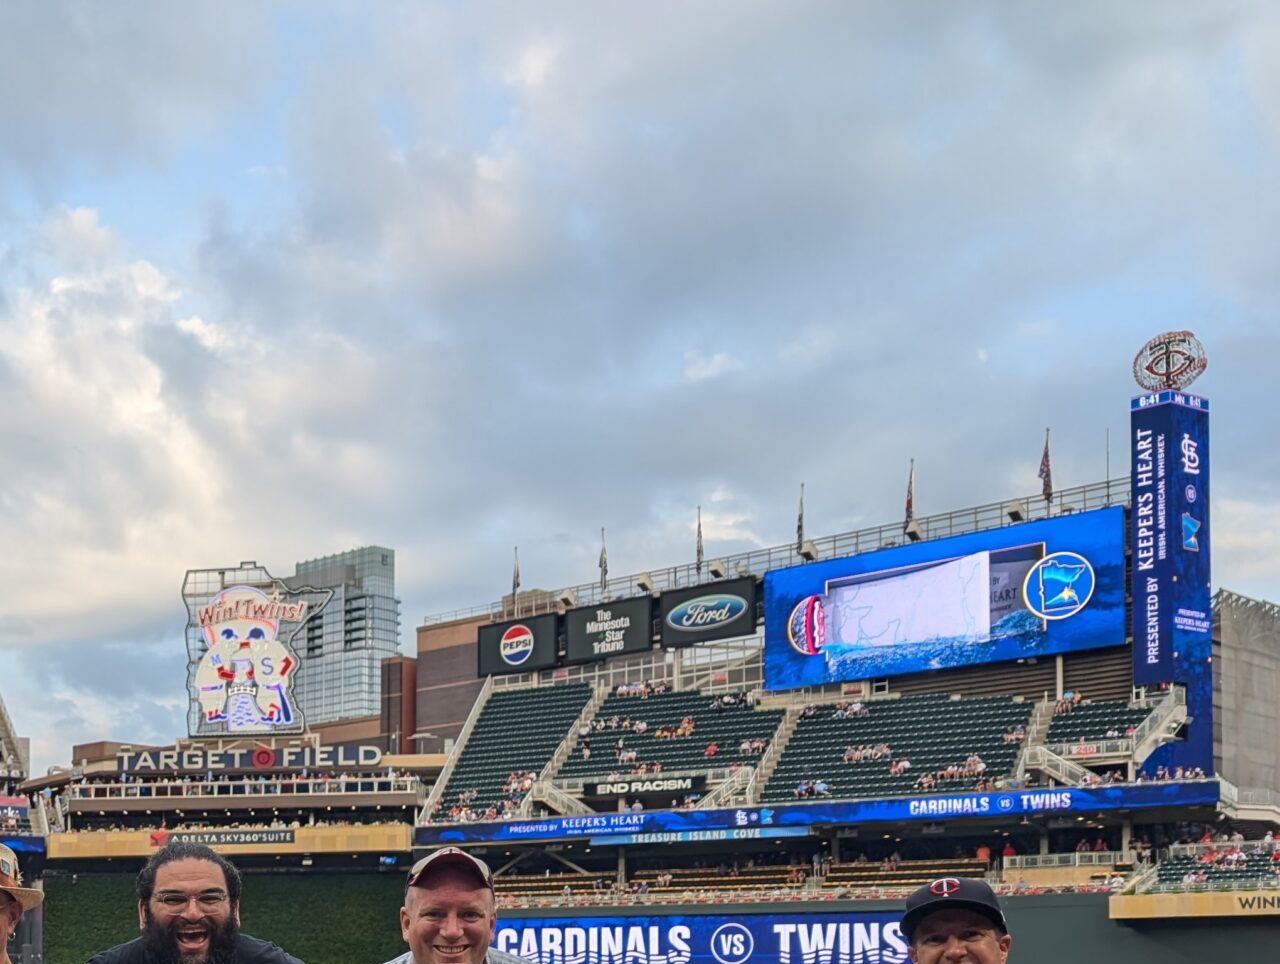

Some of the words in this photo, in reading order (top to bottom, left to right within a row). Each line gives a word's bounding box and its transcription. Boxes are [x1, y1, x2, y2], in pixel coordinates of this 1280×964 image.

[1137, 429, 1153, 487] HEART
[1137, 492, 1154, 571] KEEPER'S
[1147, 577, 1158, 593] BY
[242, 597, 303, 621] Twins!
[596, 610, 612, 622] The
[682, 604, 729, 626] Ford
[586, 616, 630, 634] Minnesota
[1147, 596, 1158, 664] PRESENTED
[605, 630, 624, 642] Star
[503, 638, 532, 655] PEPSI
[593, 640, 624, 655] Tribune
[116, 748, 247, 772] TARGET
[282, 744, 383, 768] FIELD
[597, 782, 630, 794] END
[631, 779, 692, 792] RACISM
[910, 797, 990, 815] CARDINALS
[1000, 798, 1011, 807] VS
[1020, 793, 1071, 810] TWINS
[509, 824, 549, 833] PRESENTED
[549, 824, 558, 832] BY
[562, 816, 607, 829] KEEPER'S
[610, 814, 646, 826] HEART
[182, 833, 218, 843] DELTA
[262, 831, 292, 842] SUITE
[631, 831, 685, 843] TREASURE
[688, 830, 726, 841] ISLAND
[733, 828, 761, 839] COVE
[720, 933, 746, 956] VS
[773, 922, 911, 964] TWINS
